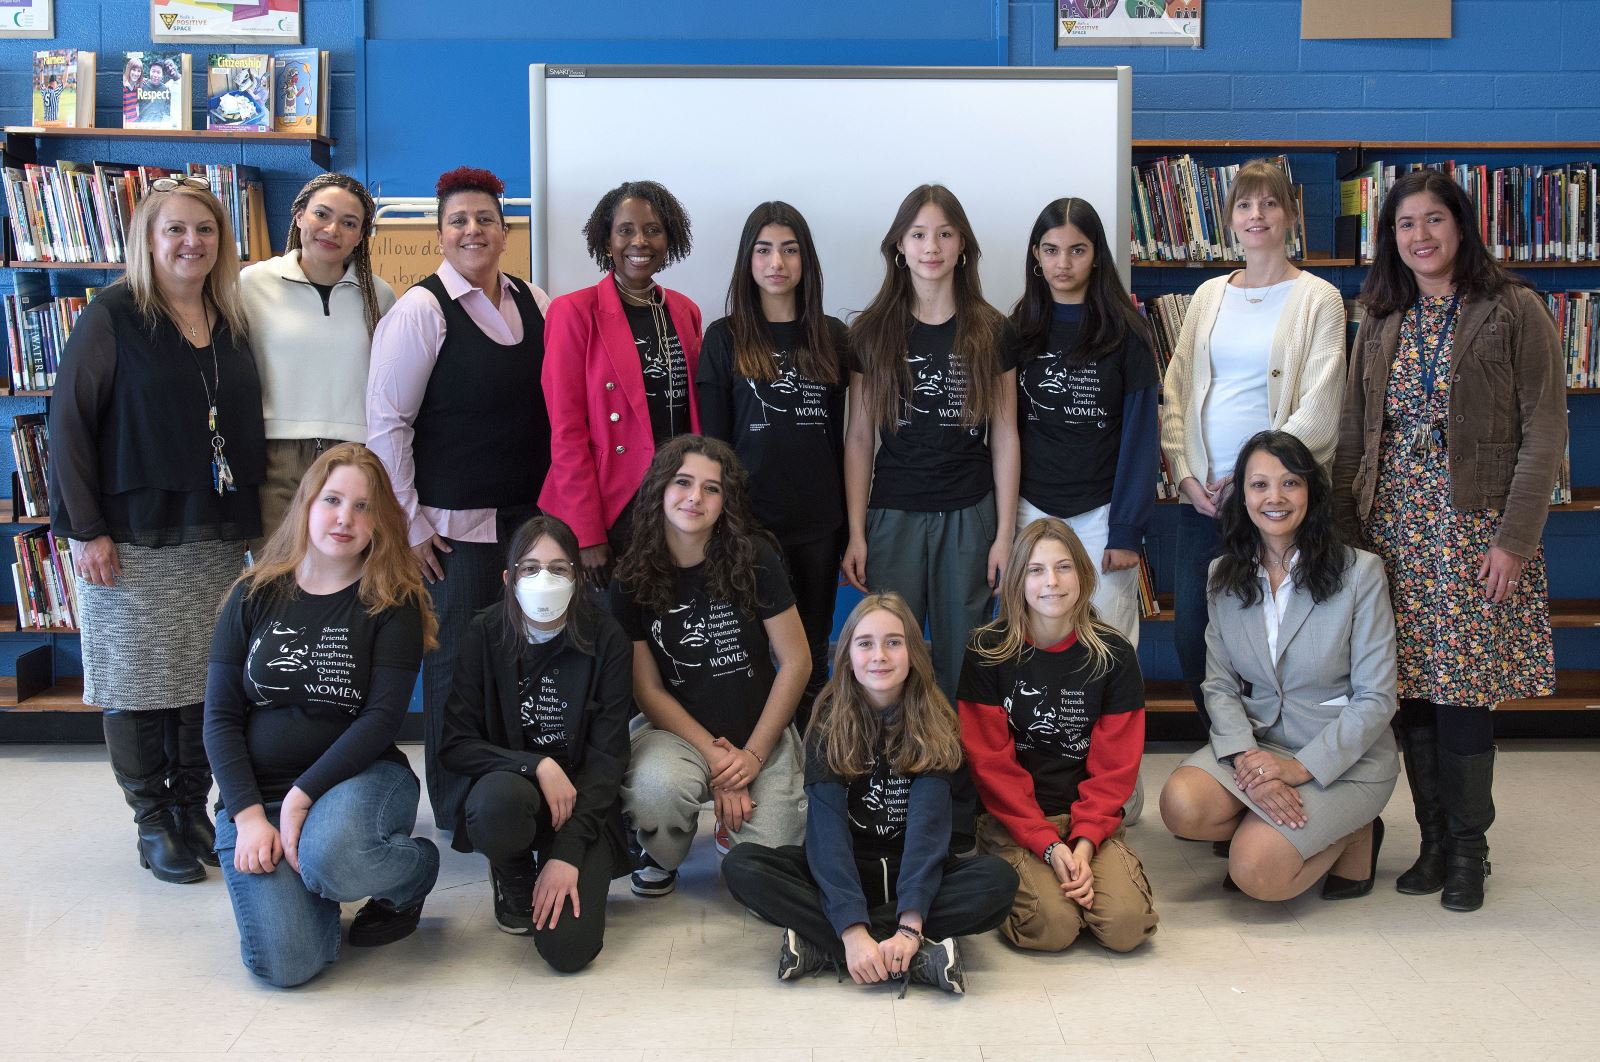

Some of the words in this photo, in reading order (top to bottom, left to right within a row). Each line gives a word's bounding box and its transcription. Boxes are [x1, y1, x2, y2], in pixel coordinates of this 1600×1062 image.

[217, 56, 261, 69] Citizenship
[137, 88, 170, 102] Respect
[369, 238, 444, 256] illowda
[31, 333, 44, 372] WATER
[709, 611, 733, 620] Mothers
[708, 620, 738, 629] Daughters
[708, 627, 740, 638] Visionaries
[715, 637, 737, 646] Queens
[717, 645, 740, 653] Leaders
[311, 651, 353, 659] Daughters
[309, 660, 356, 668] Visionaries
[317, 667, 349, 675] Queens
[319, 675, 351, 684] Leaders
[533, 731, 566, 745] WOME
